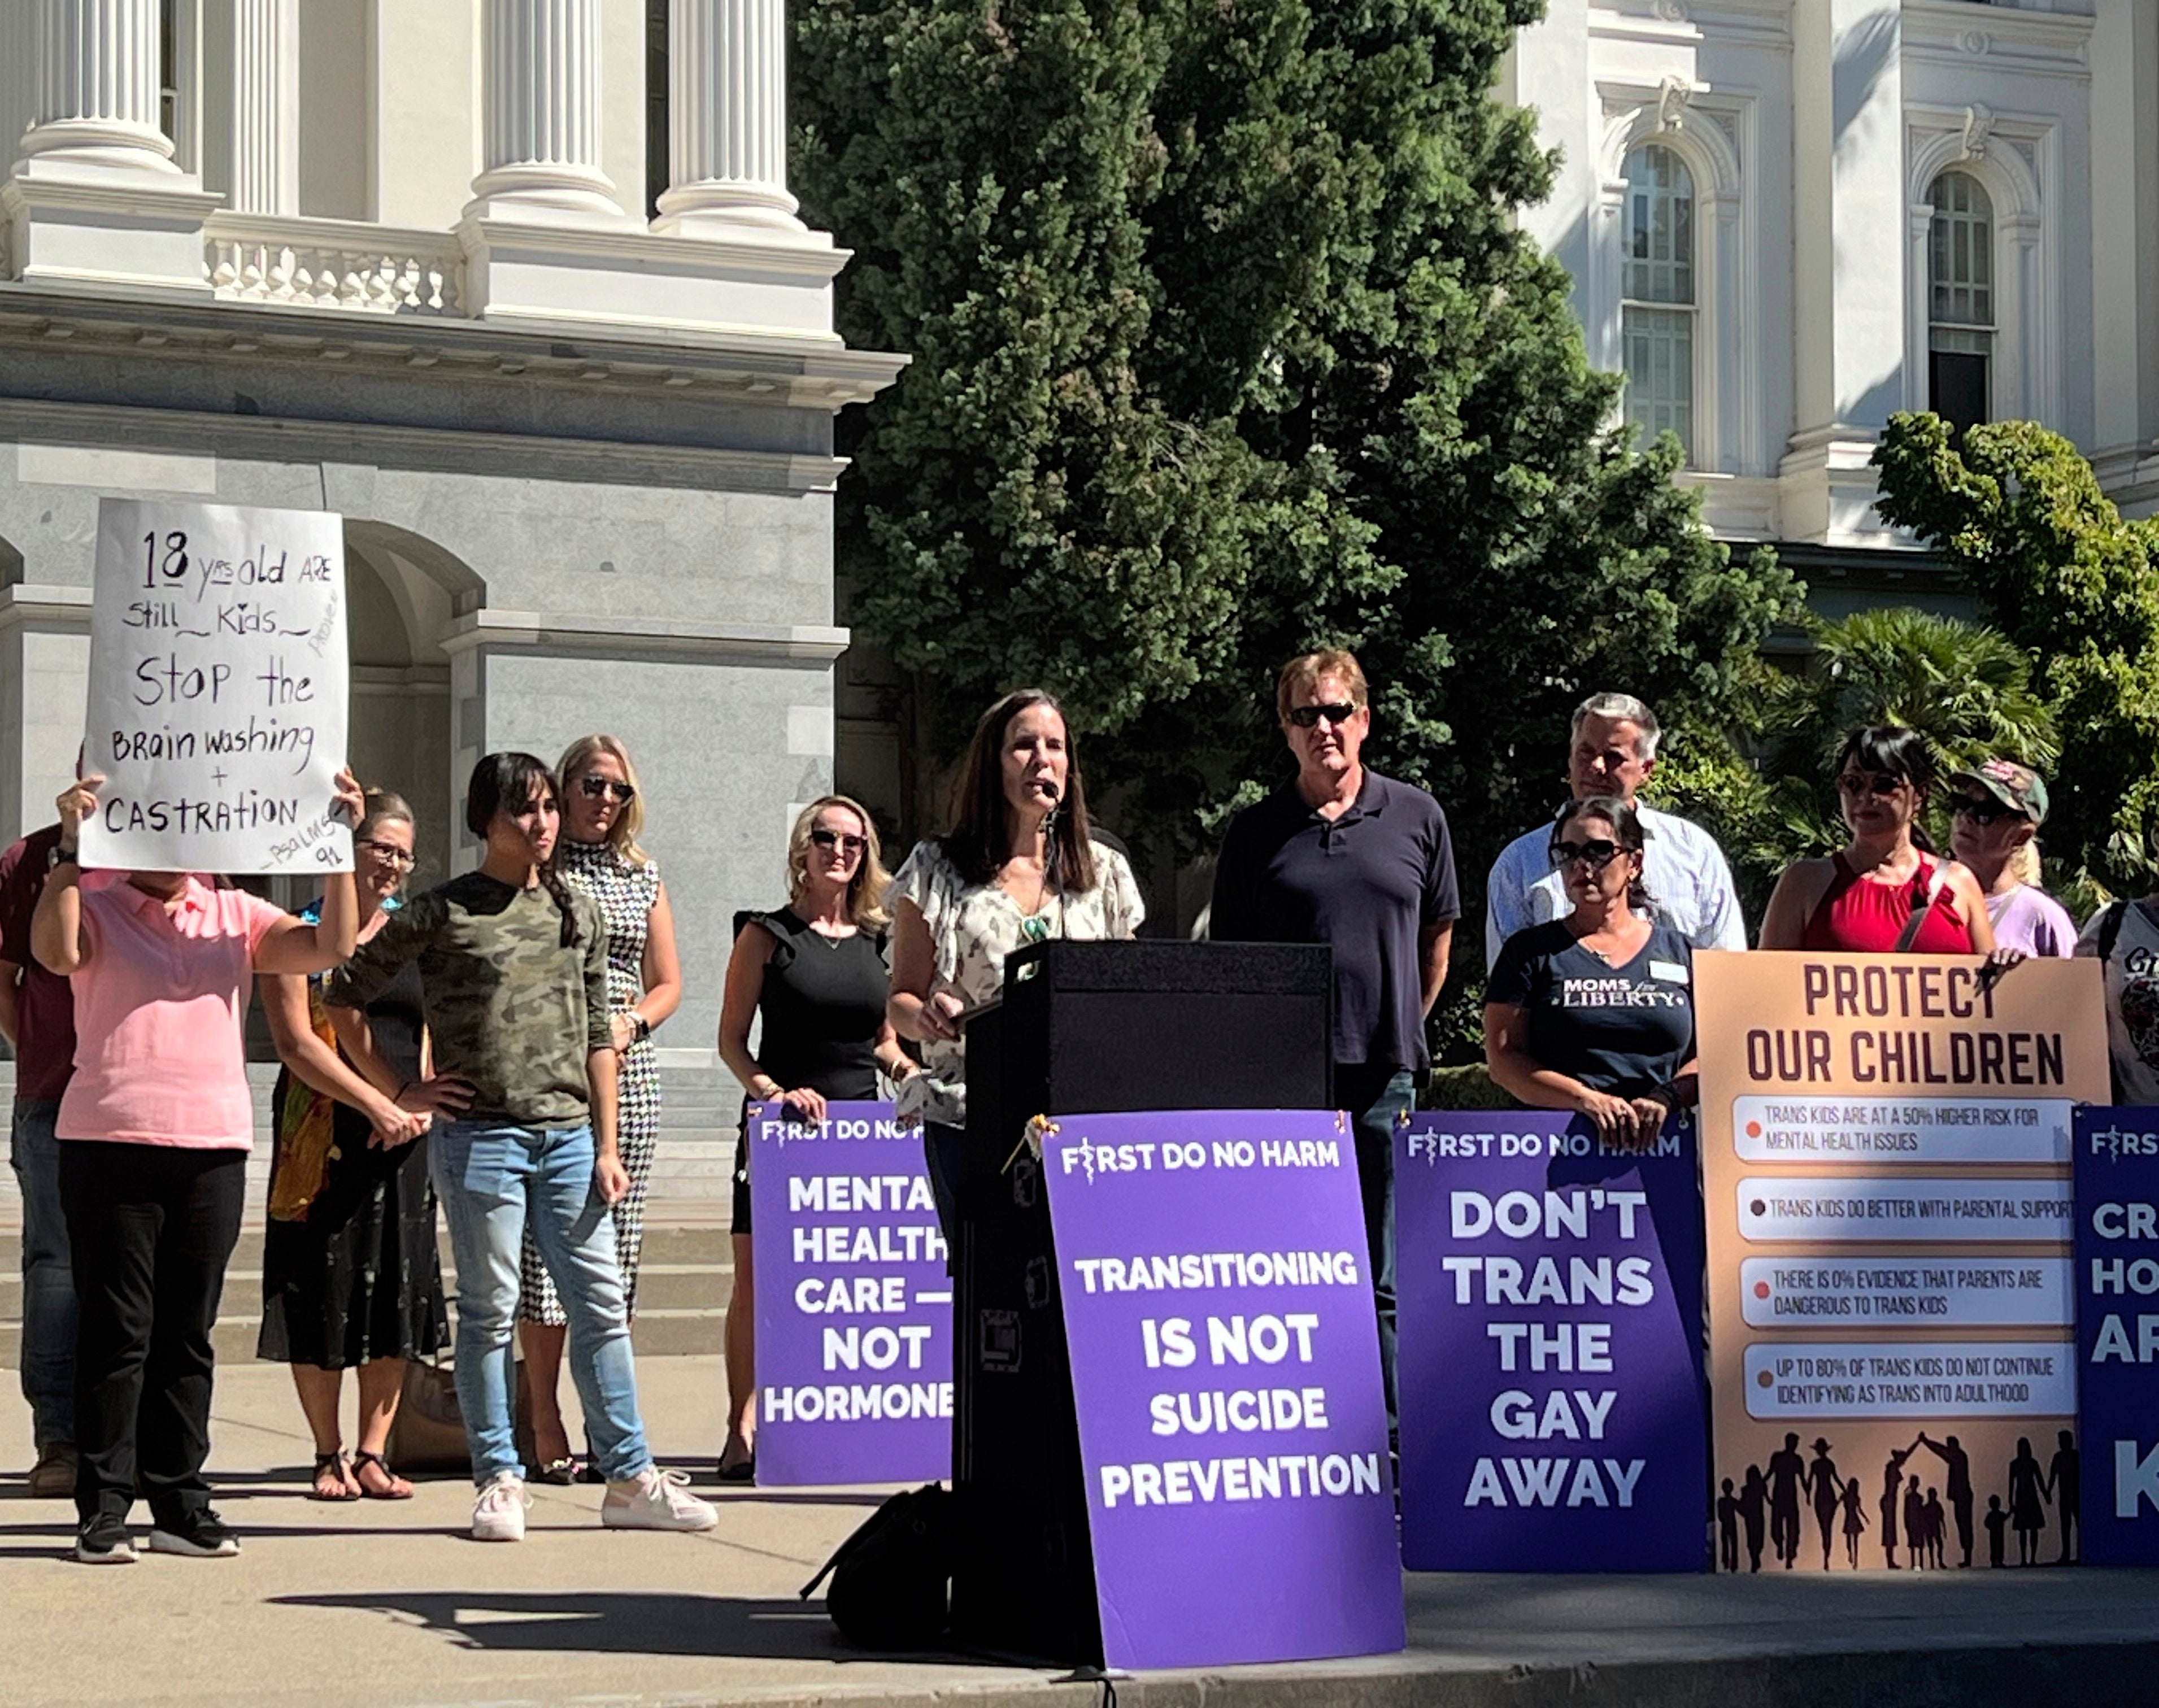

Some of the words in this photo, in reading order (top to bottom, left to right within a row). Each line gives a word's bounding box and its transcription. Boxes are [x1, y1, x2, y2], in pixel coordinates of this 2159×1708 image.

[143, 531, 188, 588] 18
[298, 555, 332, 583] ARE
[122, 600, 179, 629] Still
[217, 603, 277, 635] Kids
[256, 654, 314, 707] the
[316, 845, 343, 867] 91
[1562, 991, 1674, 1007] LIBERTY
[1564, 979, 1631, 992] MOMS
[1804, 964, 1995, 1018] PROTECT
[1747, 1030, 1832, 1082] OUR
[1851, 1031, 2064, 1085] CHILDREN
[837, 1119, 869, 1139] DO
[875, 1119, 907, 1139] NO
[1765, 1105, 1807, 1124] TRANS
[1811, 1105, 1839, 1124] KIDS
[1843, 1106, 1867, 1125] ARE
[1871, 1106, 1887, 1125] AT
[1891, 1107, 1900, 1125] A
[1904, 1107, 1933, 1126] 50%
[1935, 1107, 1979, 1126] HIGHER
[1983, 1108, 2011, 1126] RISK
[2014, 1108, 2039, 1126] FOR
[1061, 1139, 1155, 1183] FIRST
[1162, 1142, 1206, 1170] DO
[1213, 1141, 1255, 1168] NO
[1261, 1140, 1340, 1167] HARM
[1408, 1127, 1495, 1166] FIRST
[1500, 1134, 1542, 1157] DO
[1549, 1134, 1591, 1157] NO
[1766, 1132, 1818, 1150] MENTAL
[1822, 1132, 1870, 1151] HEALTH
[1874, 1132, 1917, 1151] ISSUES
[790, 1175, 935, 1212] MENTA
[1770, 1199, 1812, 1217] TRANS
[1816, 1199, 1845, 1217] KIDS
[1848, 1199, 1864, 1218] DO
[1868, 1199, 1916, 1218] BETTER
[1918, 1200, 1950, 1218] WITH
[1953, 1199, 2018, 1218] PARENTAL
[1451, 1191, 1647, 1239] DON'T
[2092, 1203, 2159, 1239] CR
[793, 1226, 948, 1263] HEALTH
[1074, 1252, 1357, 1293] TRANSITIONING
[1443, 1257, 1654, 1305] TRANS
[1773, 1270, 1813, 1288] THERE
[1817, 1270, 1829, 1288] IS
[1832, 1270, 1855, 1288] 0%
[1857, 1270, 1918, 1288] EVIDENCE
[1922, 1270, 1954, 1288] THAT
[1957, 1270, 2016, 1288] PARENTS
[2018, 1270, 2043, 1288] ARE
[2091, 1258, 2159, 1294] HO
[795, 1278, 906, 1314] CARE
[1774, 1297, 1851, 1315] DANGEROUS
[1853, 1297, 1870, 1314] TO
[1873, 1297, 1916, 1314] TRANS
[1918, 1296, 1948, 1314] KIDS
[824, 1326, 931, 1370] NOT
[1142, 1318, 1196, 1368] IS
[1207, 1314, 1318, 1365] NOT
[1487, 1323, 1613, 1371] THE
[1776, 1359, 1794, 1376] UP
[1796, 1359, 1813, 1377] TO
[1816, 1359, 1847, 1376] 80%
[1849, 1359, 1866, 1376] OF
[1869, 1358, 1911, 1376] TRANS
[1914, 1358, 1943, 1376] KIDS
[1946, 1358, 1963, 1376] DO
[1966, 1358, 1990, 1375] NOT
[1994, 1358, 2054, 1376] CONTINUE
[764, 1382, 953, 1422] HORMONE
[1150, 1388, 1329, 1436] SUICIDE
[1777, 1385, 1855, 1404] IDENTIFYING
[1858, 1385, 1875, 1403] AS
[1878, 1385, 1921, 1402] TRANS
[1924, 1385, 1952, 1402] INTO
[1955, 1384, 2029, 1402] ADULTHOOD
[1490, 1391, 1617, 1439] GAY
[1101, 1453, 1381, 1507] PREVENTION
[1464, 1458, 1646, 1507] AWAY
[2115, 1440, 2159, 1518] K
